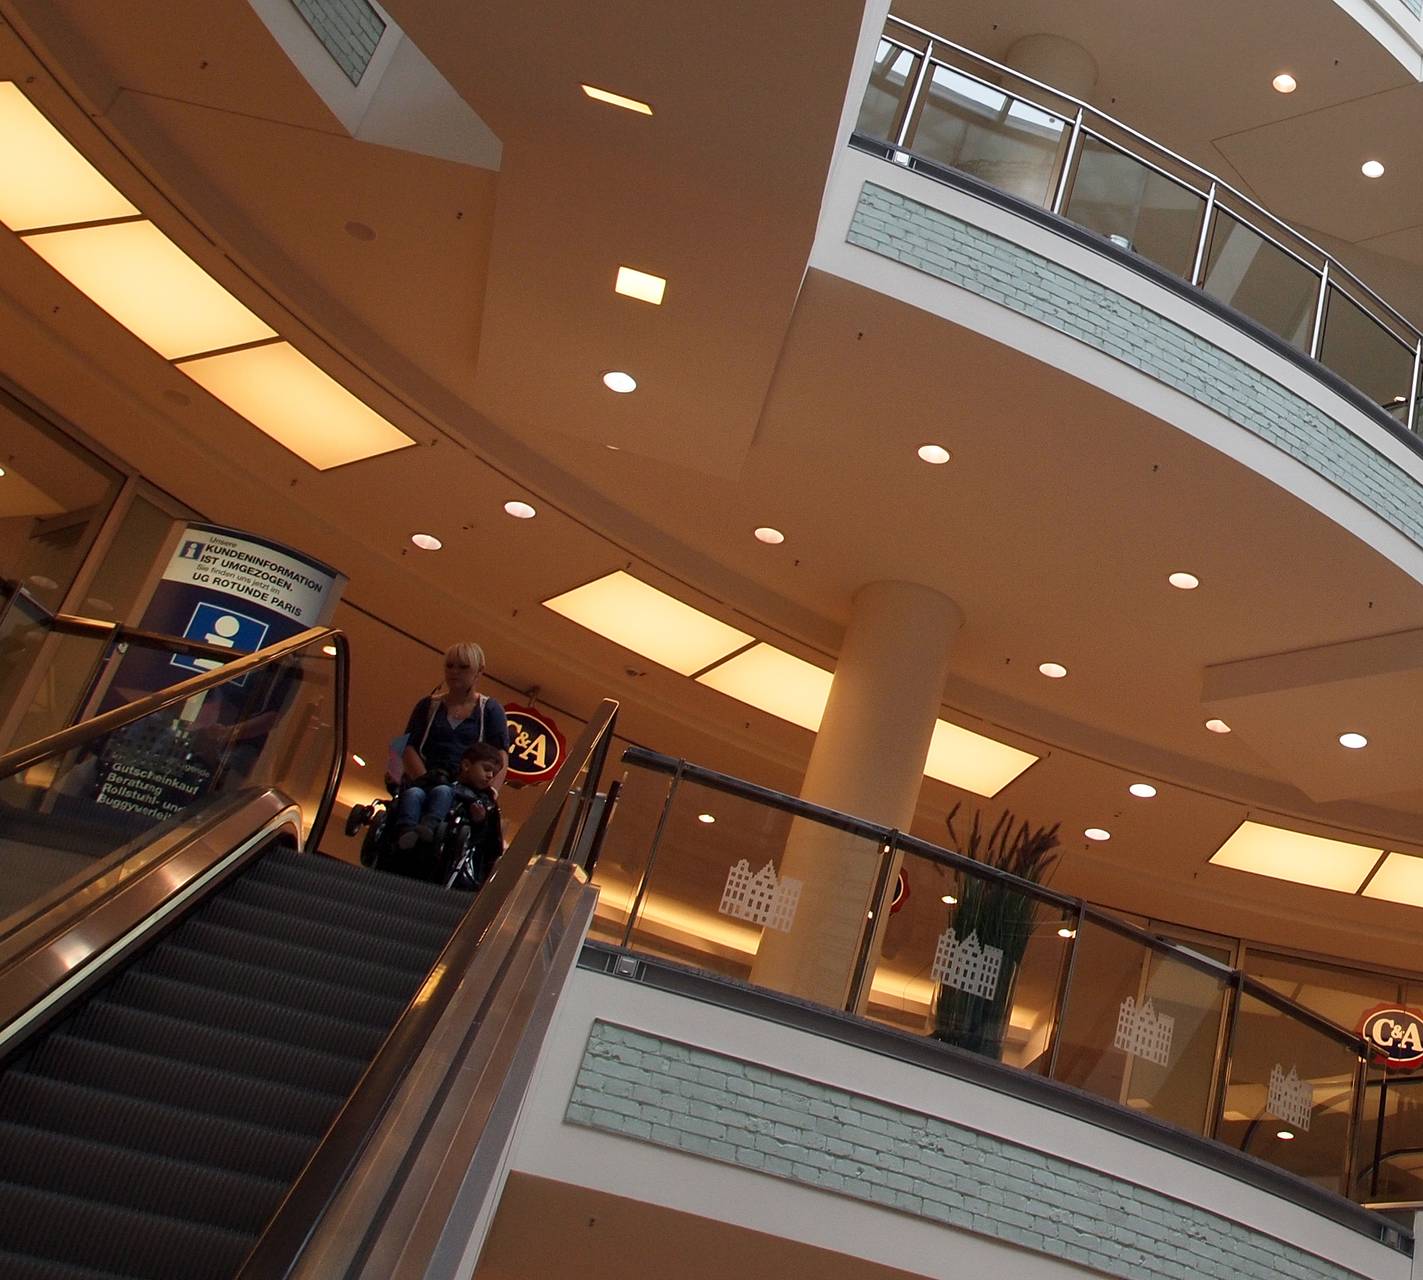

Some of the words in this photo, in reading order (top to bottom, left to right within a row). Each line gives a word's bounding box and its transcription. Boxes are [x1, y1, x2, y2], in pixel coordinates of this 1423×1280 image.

[209, 536, 238, 547] Unsere
[196, 564, 209, 573] Sie
[210, 566, 236, 579] finden
[236, 573, 251, 584] uns
[250, 577, 270, 592] jetzt
[200, 554, 220, 566] IST
[221, 557, 293, 592] UMGEZOGEN.
[205, 544, 323, 592] KUNDENINFORMATION
[192, 572, 209, 583] UG
[212, 577, 270, 602] ROTUNDE
[270, 597, 303, 617] PARIS
[101, 782, 160, 805] Rollstuhl-
[106, 772, 162, 796] Beratung
[112, 762, 200, 795] Gutscheinkauf
[96, 793, 172, 821] Buggyverlei
[1372, 1018, 1423, 1052] C&A
